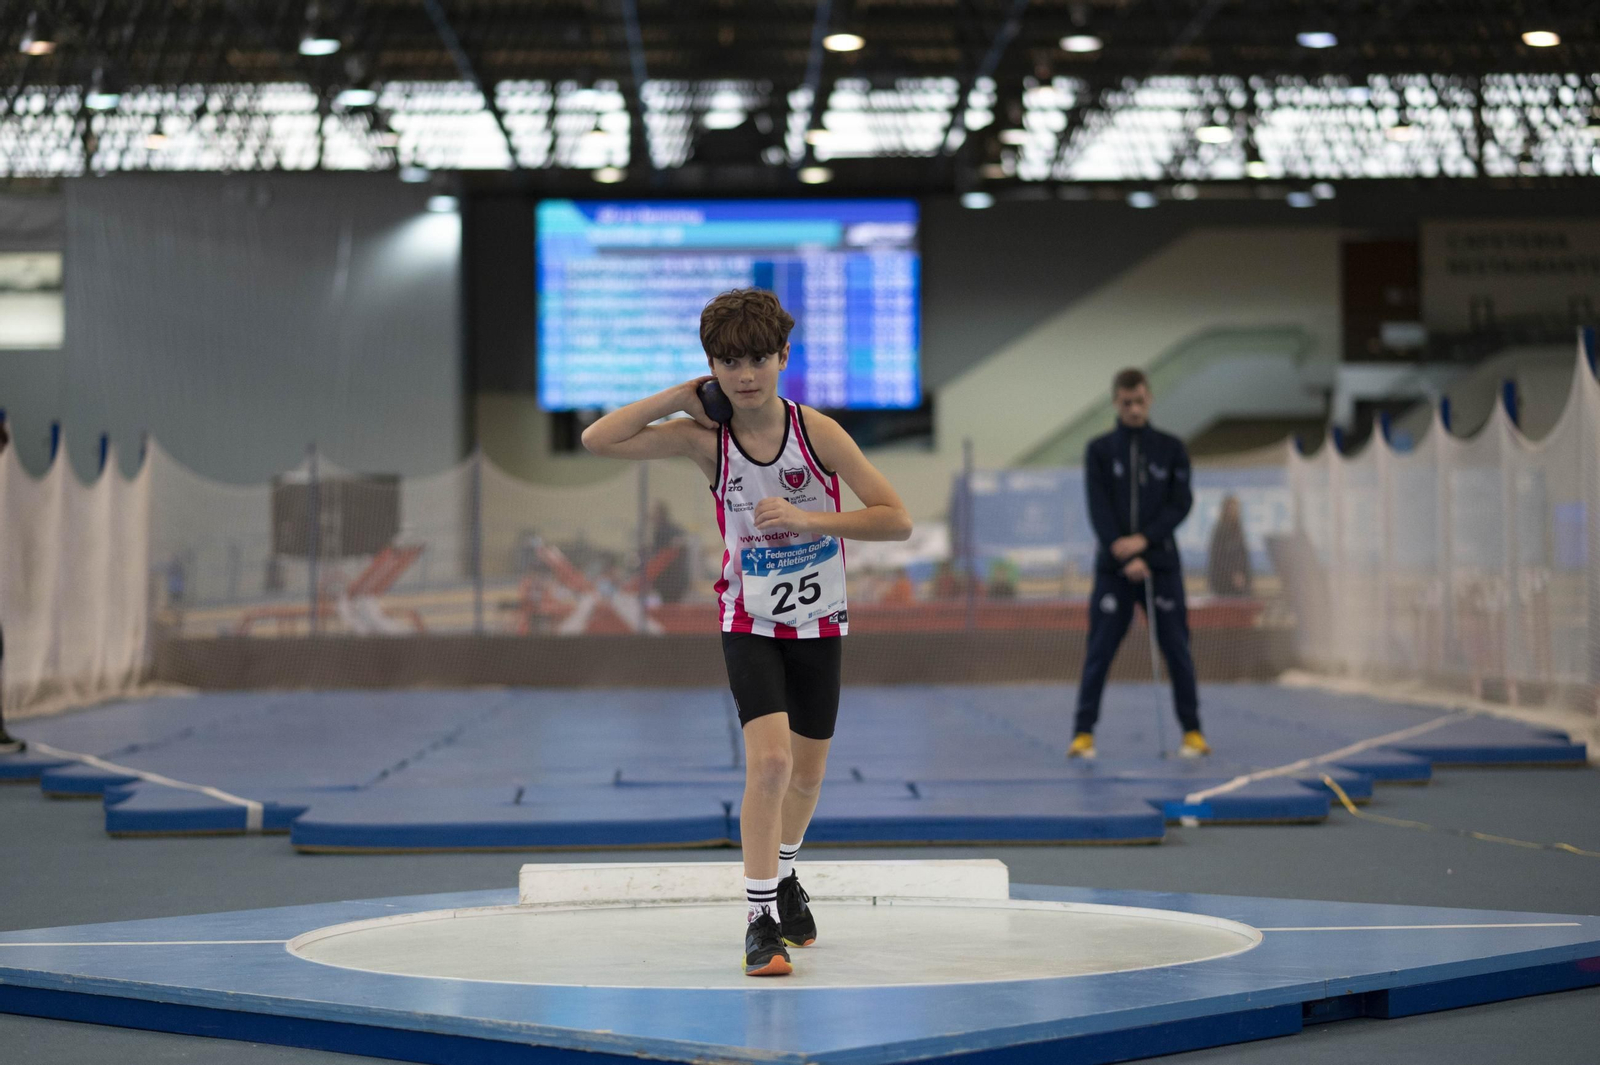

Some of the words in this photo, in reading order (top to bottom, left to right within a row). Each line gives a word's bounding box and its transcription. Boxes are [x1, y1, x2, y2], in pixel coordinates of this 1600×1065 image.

[765, 547, 807, 559] Federación
[766, 561, 776, 569] de
[777, 553, 817, 568] Atletismo
[770, 571, 821, 615] 25
